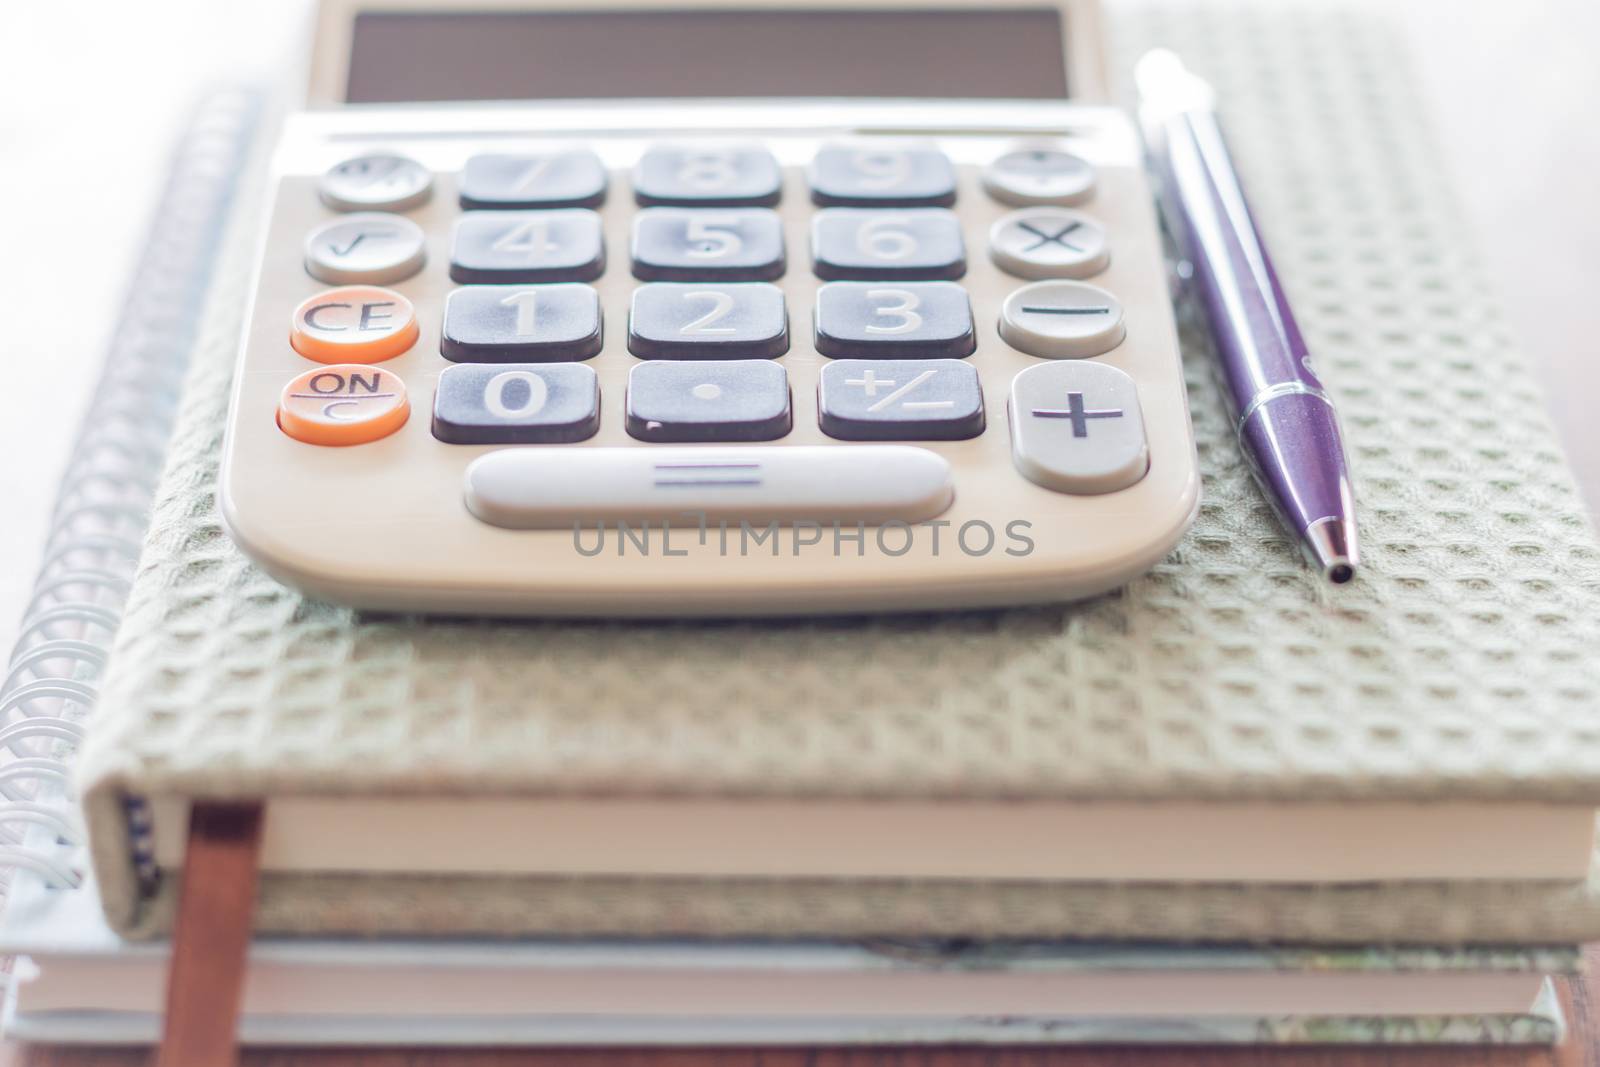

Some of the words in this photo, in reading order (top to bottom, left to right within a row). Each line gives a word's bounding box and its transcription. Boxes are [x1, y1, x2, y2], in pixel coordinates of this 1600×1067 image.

[680, 148, 738, 190] 8
[855, 146, 912, 189] 9
[490, 219, 558, 264] 4
[687, 216, 742, 259] 5
[856, 216, 918, 260] 6
[303, 301, 397, 332] CE
[501, 290, 537, 337] 1
[680, 290, 737, 336] 2
[864, 289, 923, 335] 3
[309, 372, 381, 395] ON
[484, 370, 548, 419] 0
[322, 401, 360, 421] C
